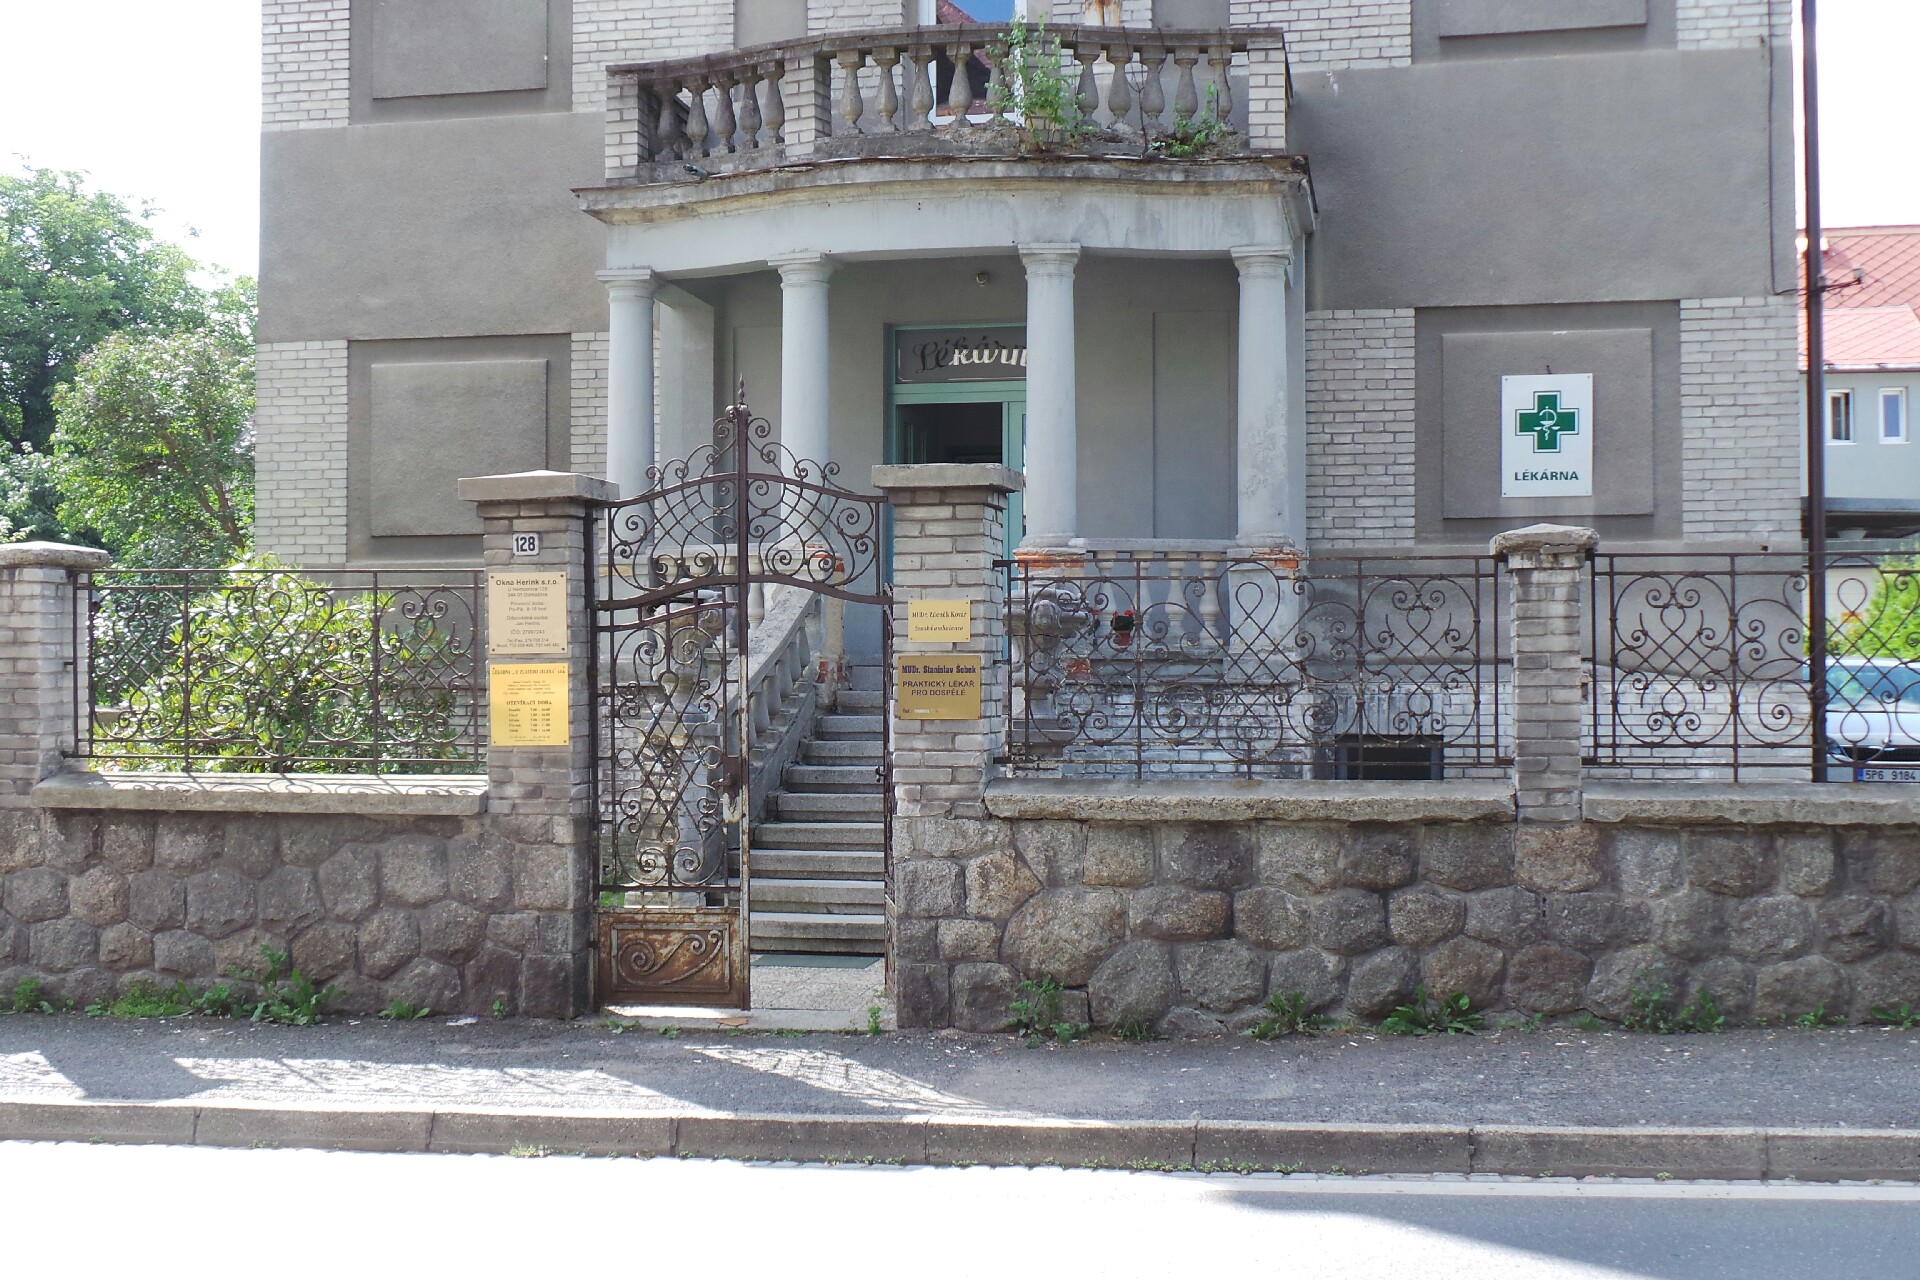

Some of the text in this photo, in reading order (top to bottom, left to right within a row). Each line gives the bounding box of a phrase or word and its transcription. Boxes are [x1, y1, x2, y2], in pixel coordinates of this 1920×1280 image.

[912, 336, 1027, 374] Lékárn
[1514, 468, 1579, 481] LÉKÁRNA
[515, 536, 535, 552] 128
[902, 664, 976, 674] MUDr. Stanislav Šebek
[1865, 770, 1916, 780] 5P6 9184
